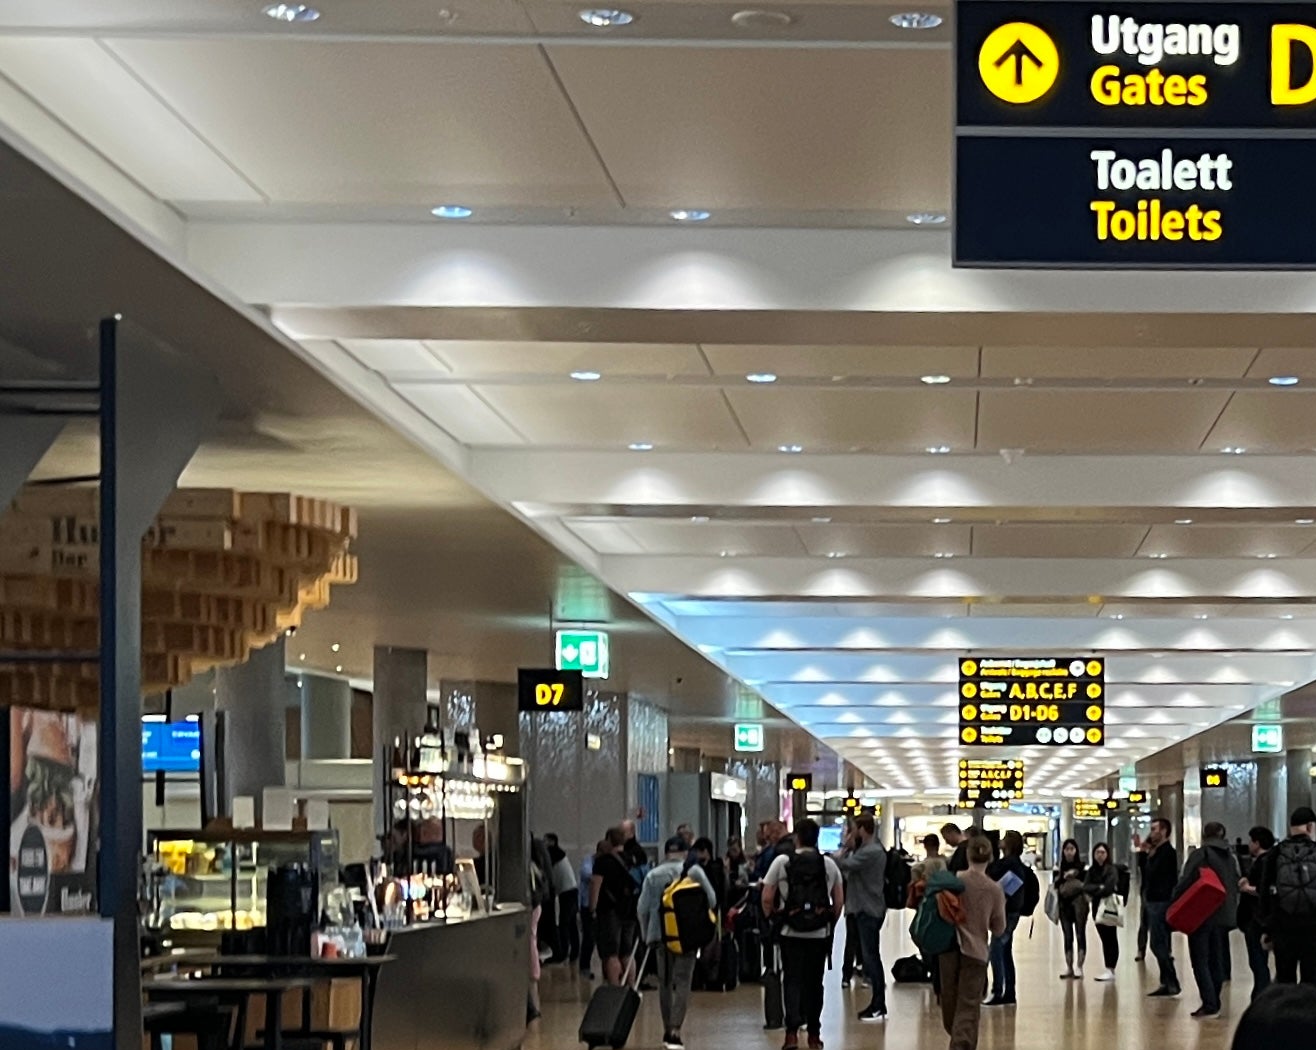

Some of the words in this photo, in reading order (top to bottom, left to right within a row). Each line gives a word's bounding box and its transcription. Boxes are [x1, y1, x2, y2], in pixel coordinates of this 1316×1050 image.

[1090, 14, 1240, 66] Utgang
[1090, 66, 1208, 107] Gates
[1090, 149, 1233, 192] Toalett
[1090, 199, 1223, 241] Toilets
[535, 683, 565, 706] D7
